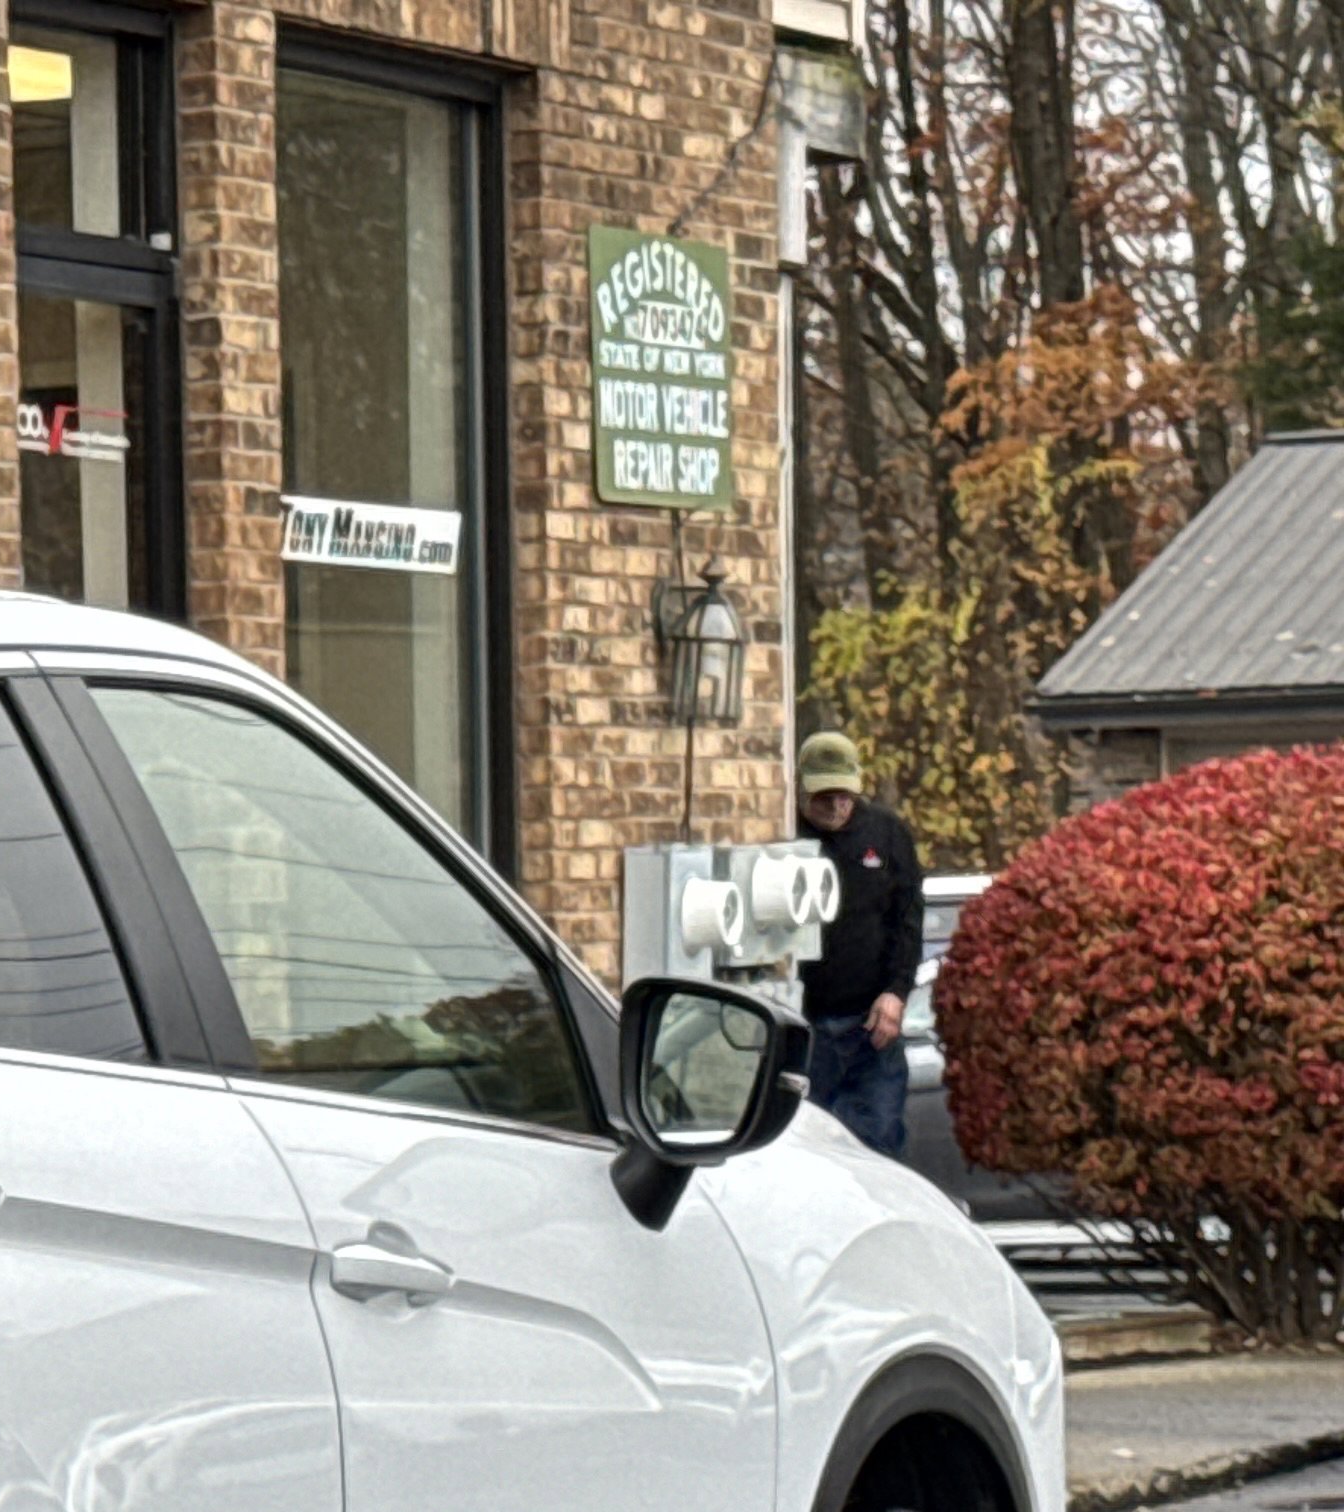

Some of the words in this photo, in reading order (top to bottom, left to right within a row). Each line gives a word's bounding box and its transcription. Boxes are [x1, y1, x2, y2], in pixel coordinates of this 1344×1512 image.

[597, 239, 725, 342] REGISTERED
[599, 338, 640, 371] STATE
[599, 376, 660, 433] MOTOR
[661, 384, 729, 439] VEHICLE
[613, 438, 673, 492] REPAIR
[677, 443, 720, 495] SHOP
